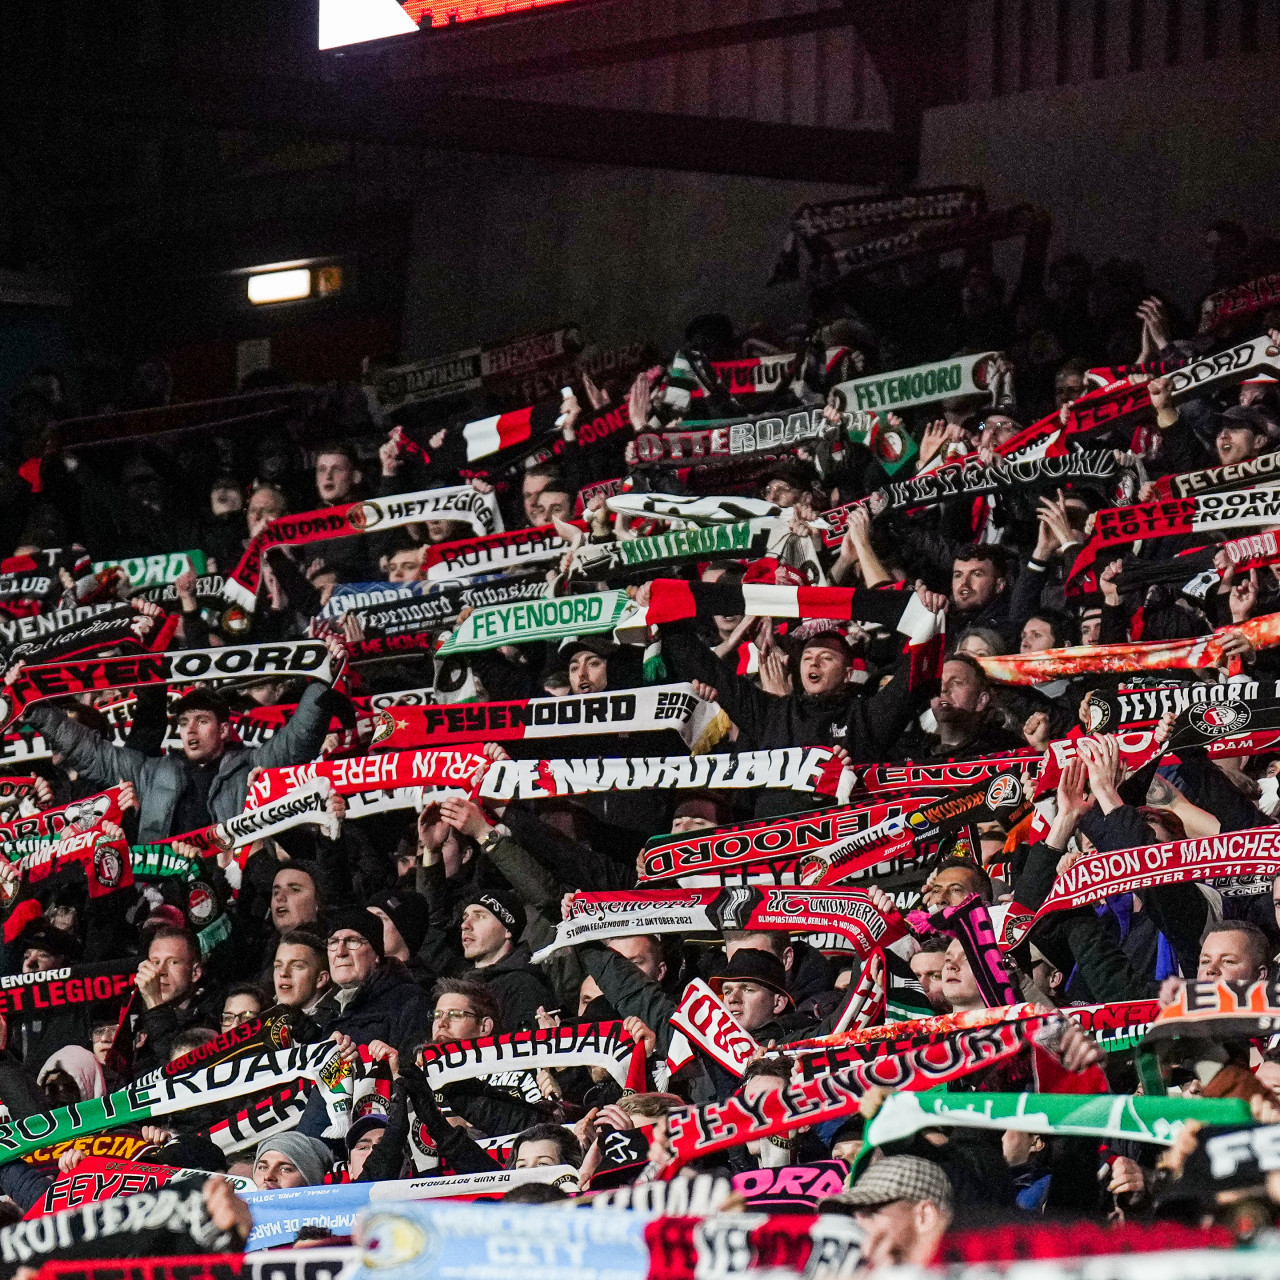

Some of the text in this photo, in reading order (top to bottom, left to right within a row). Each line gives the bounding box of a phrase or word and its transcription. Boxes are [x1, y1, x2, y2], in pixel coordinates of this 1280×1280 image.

[856, 363, 963, 411] FEYENOORD
[885, 441, 1116, 507] FEYENOORD
[389, 494, 426, 518] HET
[428, 490, 497, 537] LEGIOEN
[622, 524, 750, 564] ROTTERDAM
[358, 594, 453, 629] Feyenoord
[473, 598, 603, 638] FEYENOORD
[11, 618, 131, 661] Rotterdam
[20, 645, 326, 699] FEYENOORD
[423, 694, 634, 733] FEYENOORD
[654, 706, 695, 722] 2017
[281, 755, 400, 790] HERE WE
[232, 790, 326, 839] HET LEGIOEN
[1147, 842, 1175, 869] OF
[570, 894, 701, 921] Feyenoord
[1072, 872, 1163, 908] MANCHESTER
[635, 918, 643, 926] 21
[644, 917, 673, 927] OKTOBER
[675, 916, 691, 925] 2021
[808, 917, 828, 926] BERLIN
[857, 933, 872, 952] 2021
[809, 898, 888, 941] UNION BERLIN
[166, 1018, 264, 1075] FEYENOORD
[421, 1028, 634, 1079] ROTTERDAM
[411, 1176, 475, 1189] ROTTERDAM
[498, 1174, 511, 1183] DE
[1, 1184, 209, 1263] ROTTERDAM
